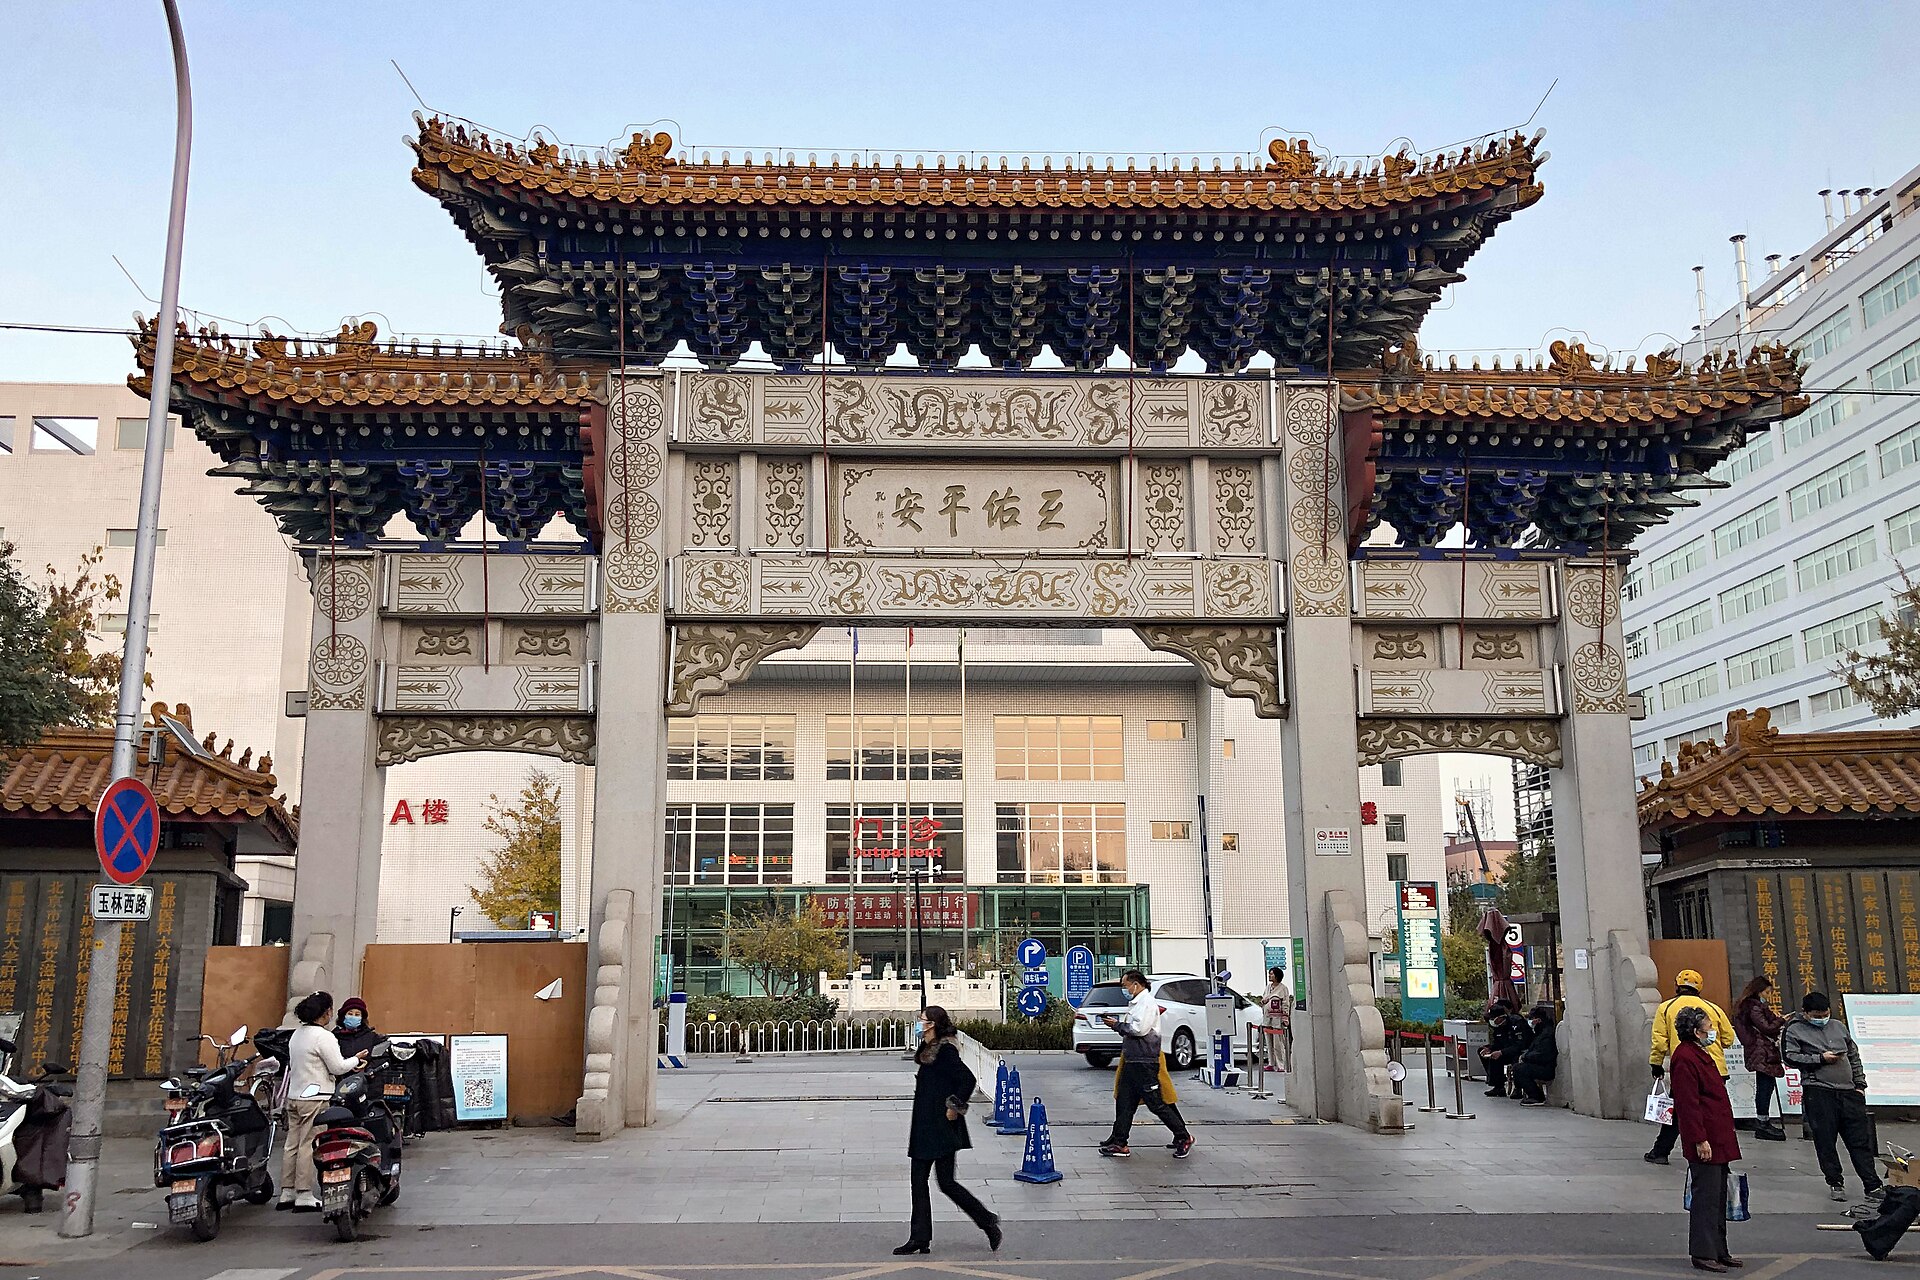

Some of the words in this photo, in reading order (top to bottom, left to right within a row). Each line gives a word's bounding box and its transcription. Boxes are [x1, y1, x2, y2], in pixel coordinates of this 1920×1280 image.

[848, 846, 943, 859] Outpatient
[98, 892, 147, 915] 玉林西路
[827, 896, 892, 909] 防疫有我
[1508, 926, 1518, 942] 5
[1860, 876, 1889, 992] 国家药物临床
[144, 880, 177, 1075] 首都医科大学附属北京佑安医院
[1785, 1066, 1803, 1106] 已满
